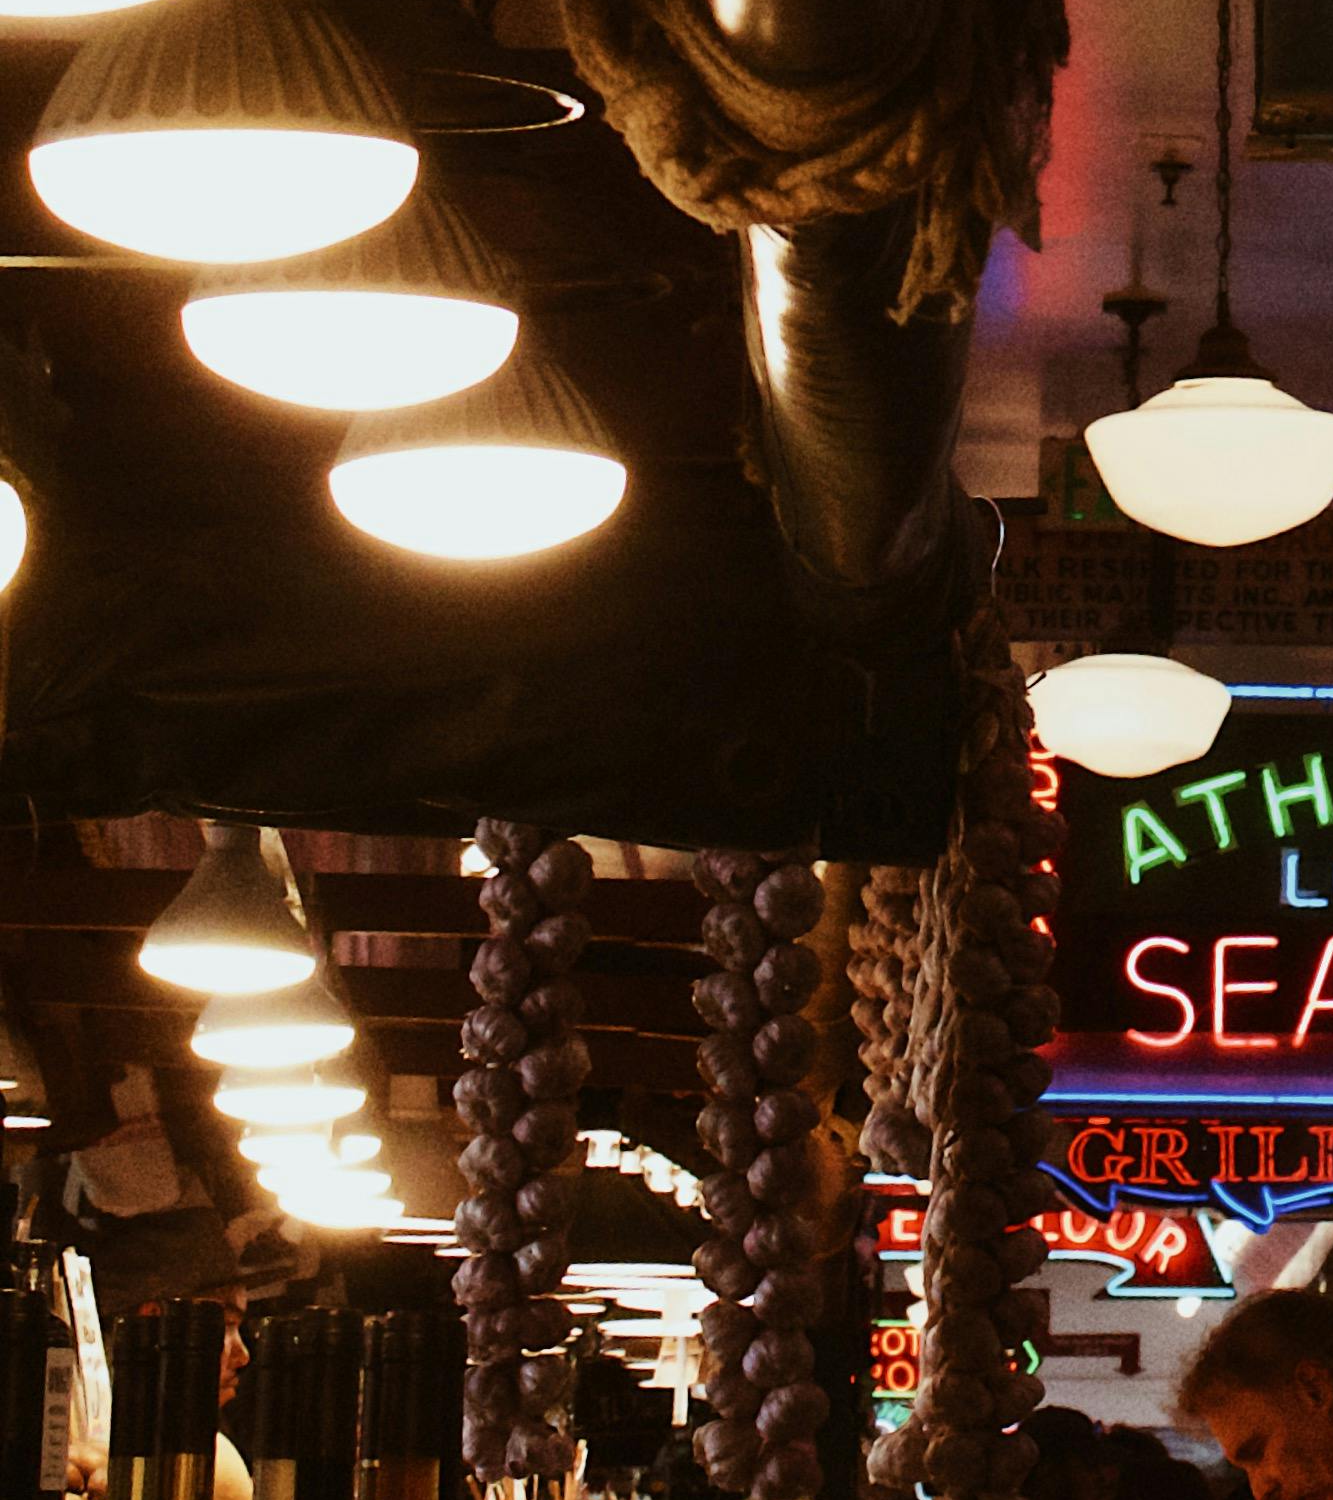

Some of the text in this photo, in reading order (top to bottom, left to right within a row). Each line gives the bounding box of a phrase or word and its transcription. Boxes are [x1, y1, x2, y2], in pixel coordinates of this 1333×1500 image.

[1058, 556, 1219, 581] RESERED
[1237, 558, 1290, 581] FOR
[998, 584, 1072, 606] UBLIC
